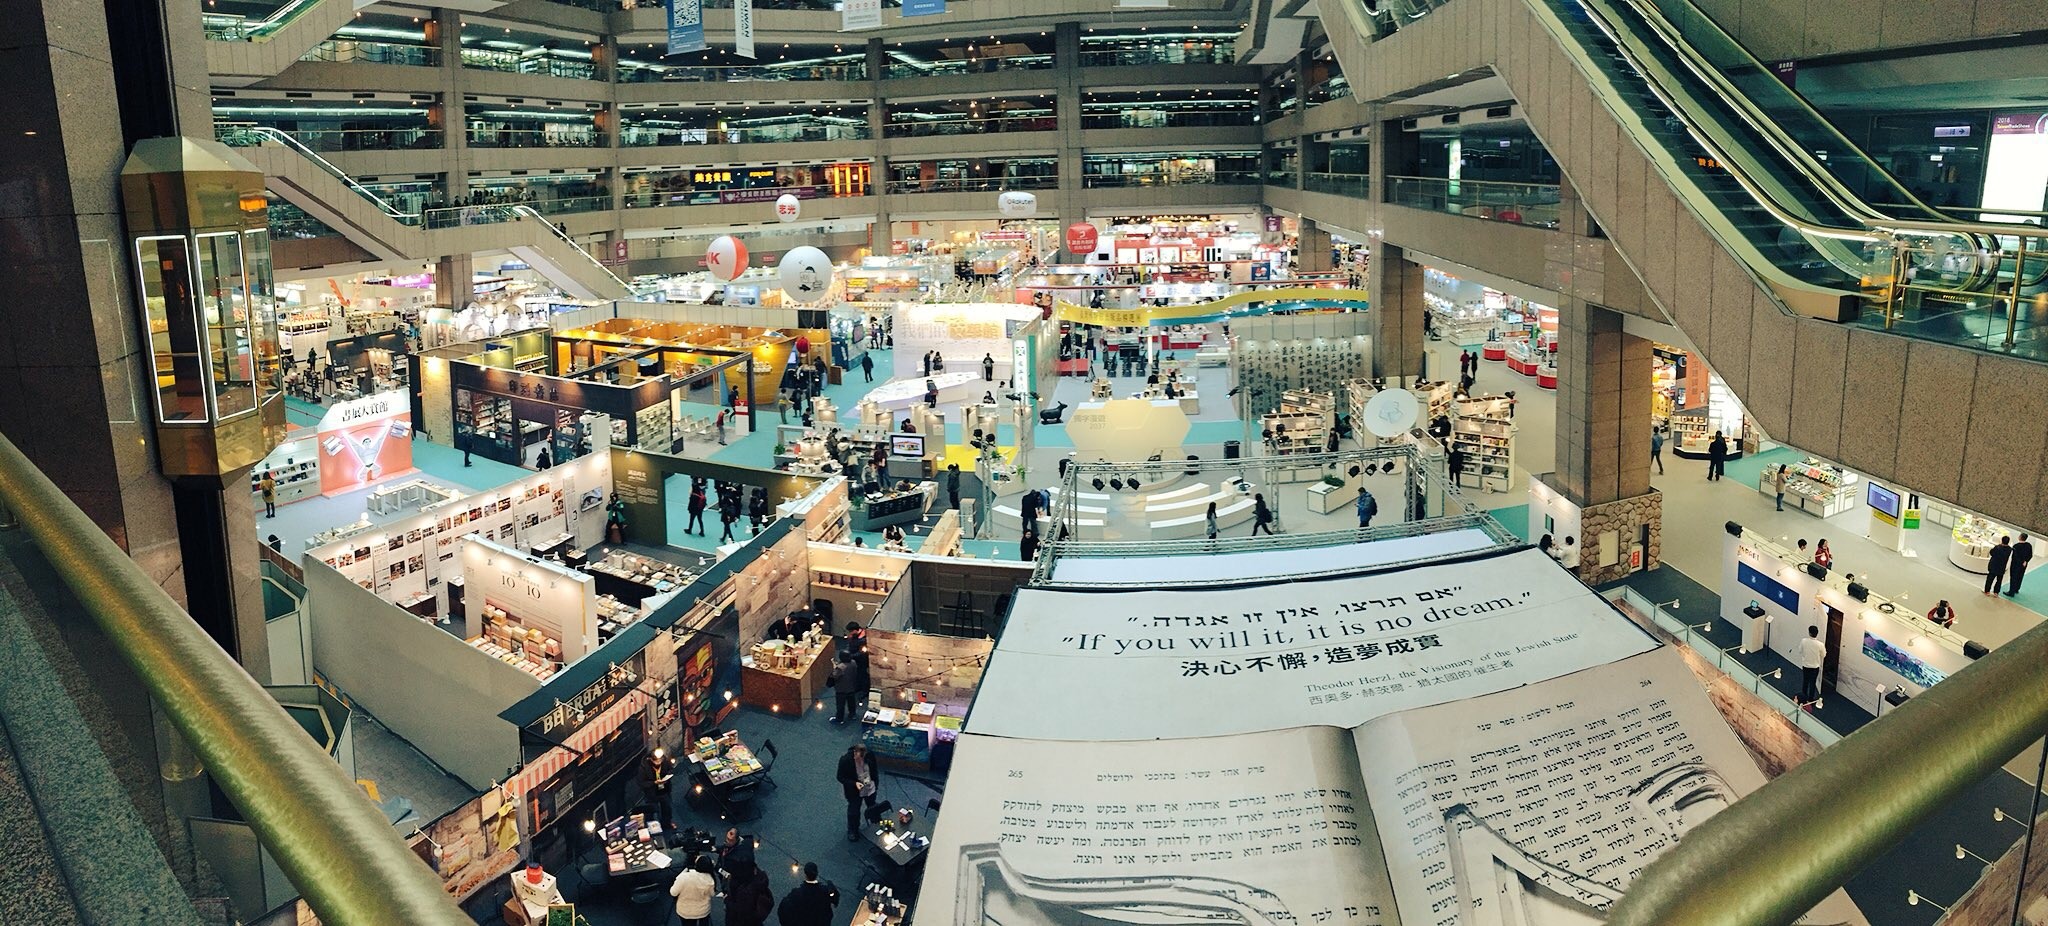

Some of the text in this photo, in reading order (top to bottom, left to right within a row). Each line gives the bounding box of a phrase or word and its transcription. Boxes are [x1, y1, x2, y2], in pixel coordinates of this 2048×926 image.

[1334, 597, 1407, 616] תרצו,
[1242, 612, 1263, 623] זו
[1276, 606, 1319, 625] אין
[1113, 637, 1176, 656] you
[1187, 630, 1250, 650] will
[1262, 627, 1295, 646] it,
[1306, 622, 1331, 641] it
[1339, 619, 1367, 638] is
[1375, 613, 1413, 634] no
[1304, 677, 1356, 694] Theodor
[1398, 667, 1418, 681] the
[1419, 657, 1474, 675] Visionary
[1479, 652, 1491, 662] of
[1493, 648, 1512, 659] the
[1515, 640, 1552, 655] Jewish
[1553, 631, 1580, 646] State
[1556, 700, 1575, 711] תמול
[1647, 709, 1672, 724] שאמרו
[1584, 718, 1608, 731] אותנו
[1622, 720, 1642, 734] שרוב
[1656, 720, 1680, 735] חכמים
[1613, 730, 1652, 751] הראשונים
[1543, 746, 1562, 758] אלא
[1635, 744, 1655, 758] עמדו
[1678, 742, 1695, 754] מכל
[1506, 753, 1539, 770] תולדות
[1609, 753, 1633, 769] ונתנו
[1008, 769, 1023, 778] 265
[1221, 767, 1240, 777] אחד
[1247, 765, 1265, 776] פרק
[1505, 768, 1539, 785] התחילו
[1579, 763, 1602, 777] עלינו
[1620, 764, 1642, 777] שהרי
[1096, 773, 1134, 782] ירושלים
[1547, 772, 1574, 789] מצוות
[1604, 774, 1617, 784] כל
[1582, 780, 1598, 792] זמן
[1303, 787, 1327, 800] שלא
[1331, 788, 1352, 800] אחיו
[1430, 789, 1454, 802] שמא
[1555, 786, 1576, 801] שהיו
[1051, 803, 1085, 814] מיצחק
[1096, 803, 1127, 815] מבקש
[1136, 803, 1157, 813] הוא
[1164, 803, 1179, 813] אף
[1229, 796, 1267, 809] נגררים
[1328, 802, 1355, 815] לאחיו
[1519, 796, 1549, 813] ישראל
[1576, 798, 1588, 811] לב
[1236, 810, 1264, 825] לארץ
[1552, 807, 1569, 819] טוב
[1575, 811, 1602, 827] עכשיו
[1046, 818, 1087, 830] ולשבוע
[1142, 815, 1176, 829] לעבוד
[1182, 816, 1227, 828] הקדושה
[1287, 822, 1301, 834] כל
[1309, 818, 1328, 831] כלו
[1621, 816, 1637, 829] אין
[1543, 824, 1566, 839] שאנו
[1036, 835, 1065, 846] יעשה
[1072, 836, 1092, 847] ומה
[1312, 838, 1328, 849] את
[1332, 834, 1362, 847] לכתוב
[1607, 832, 1635, 850] לעתיד
[1242, 846, 1263, 857] הוא
[1271, 841, 1302, 855] האמת
[1113, 855, 1136, 864] אינו
[1311, 906, 1332, 924] לכך
[1344, 905, 1359, 919] כך
[1365, 904, 1381, 918] בין
